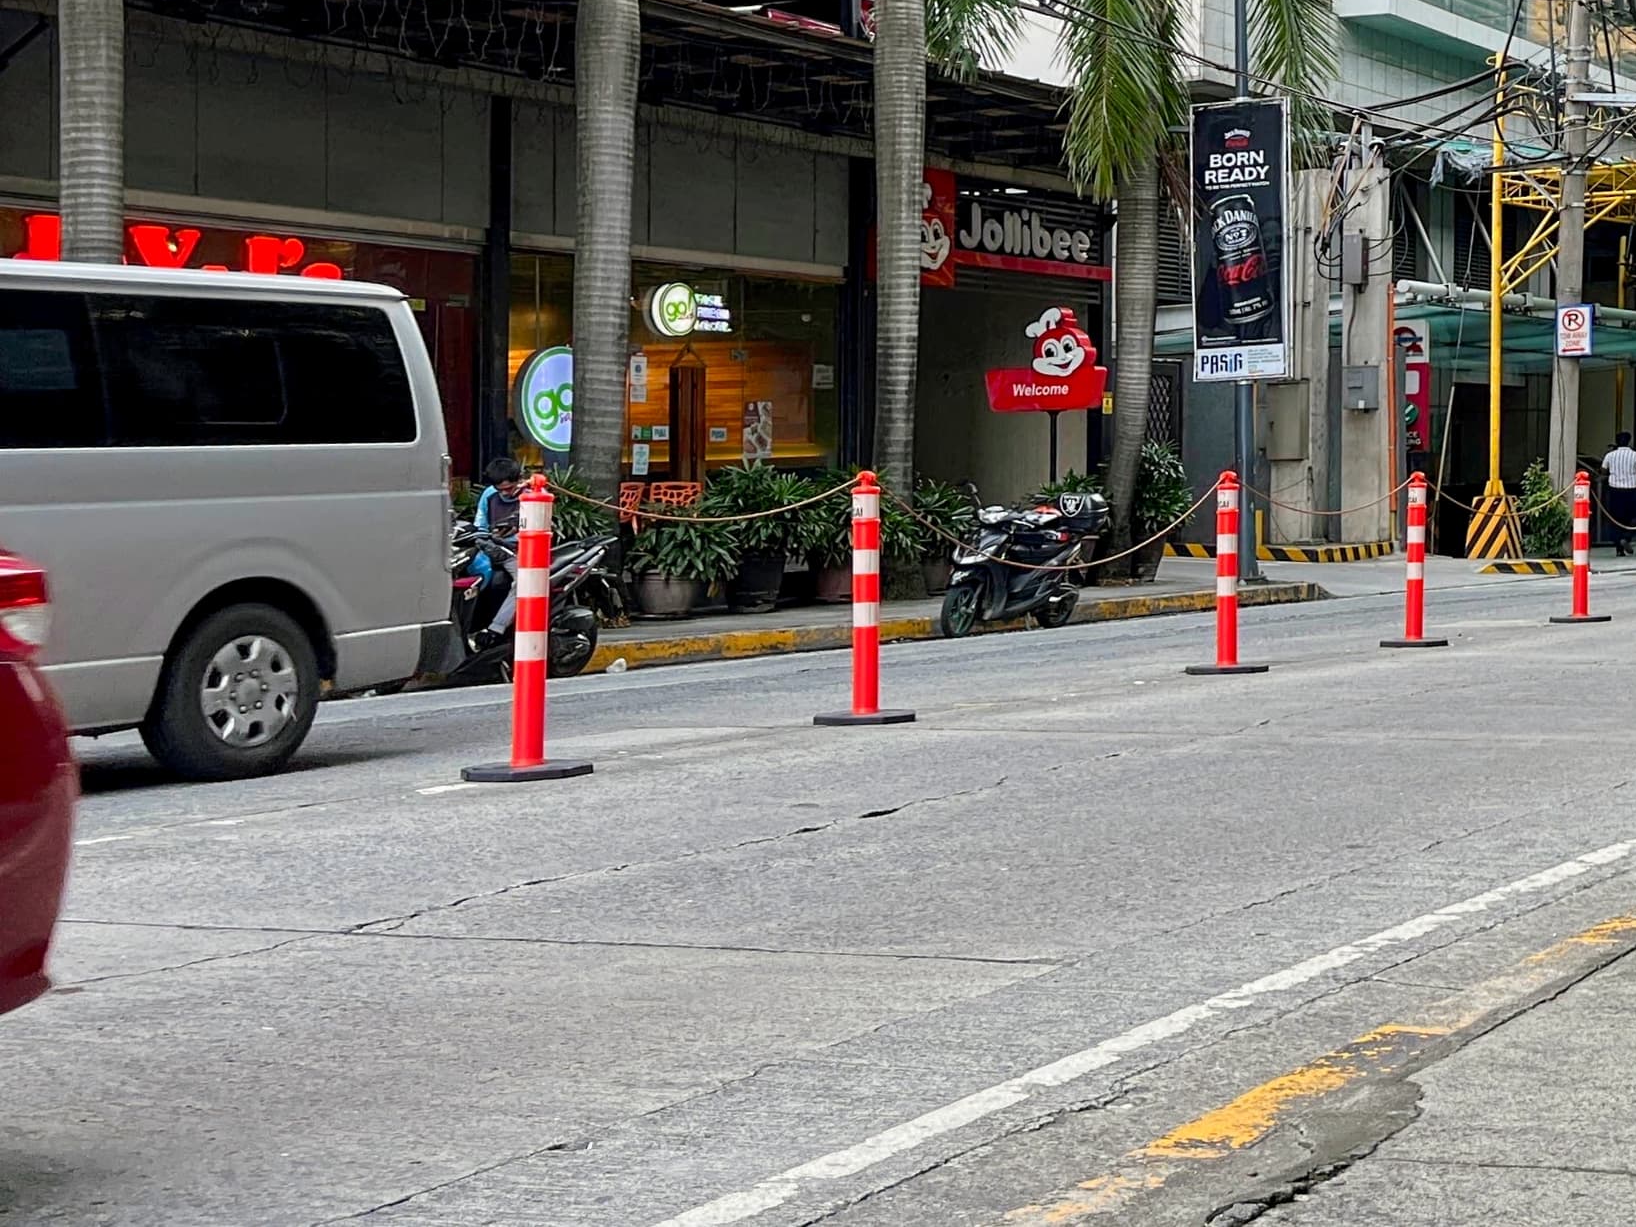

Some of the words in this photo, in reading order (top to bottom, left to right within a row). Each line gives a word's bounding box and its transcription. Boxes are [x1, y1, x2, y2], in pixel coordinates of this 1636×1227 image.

[1209, 150, 1264, 168] BORN
[1204, 165, 1270, 184] READY
[959, 202, 1091, 263] Jollibee
[1012, 382, 1070, 397] Welcome
